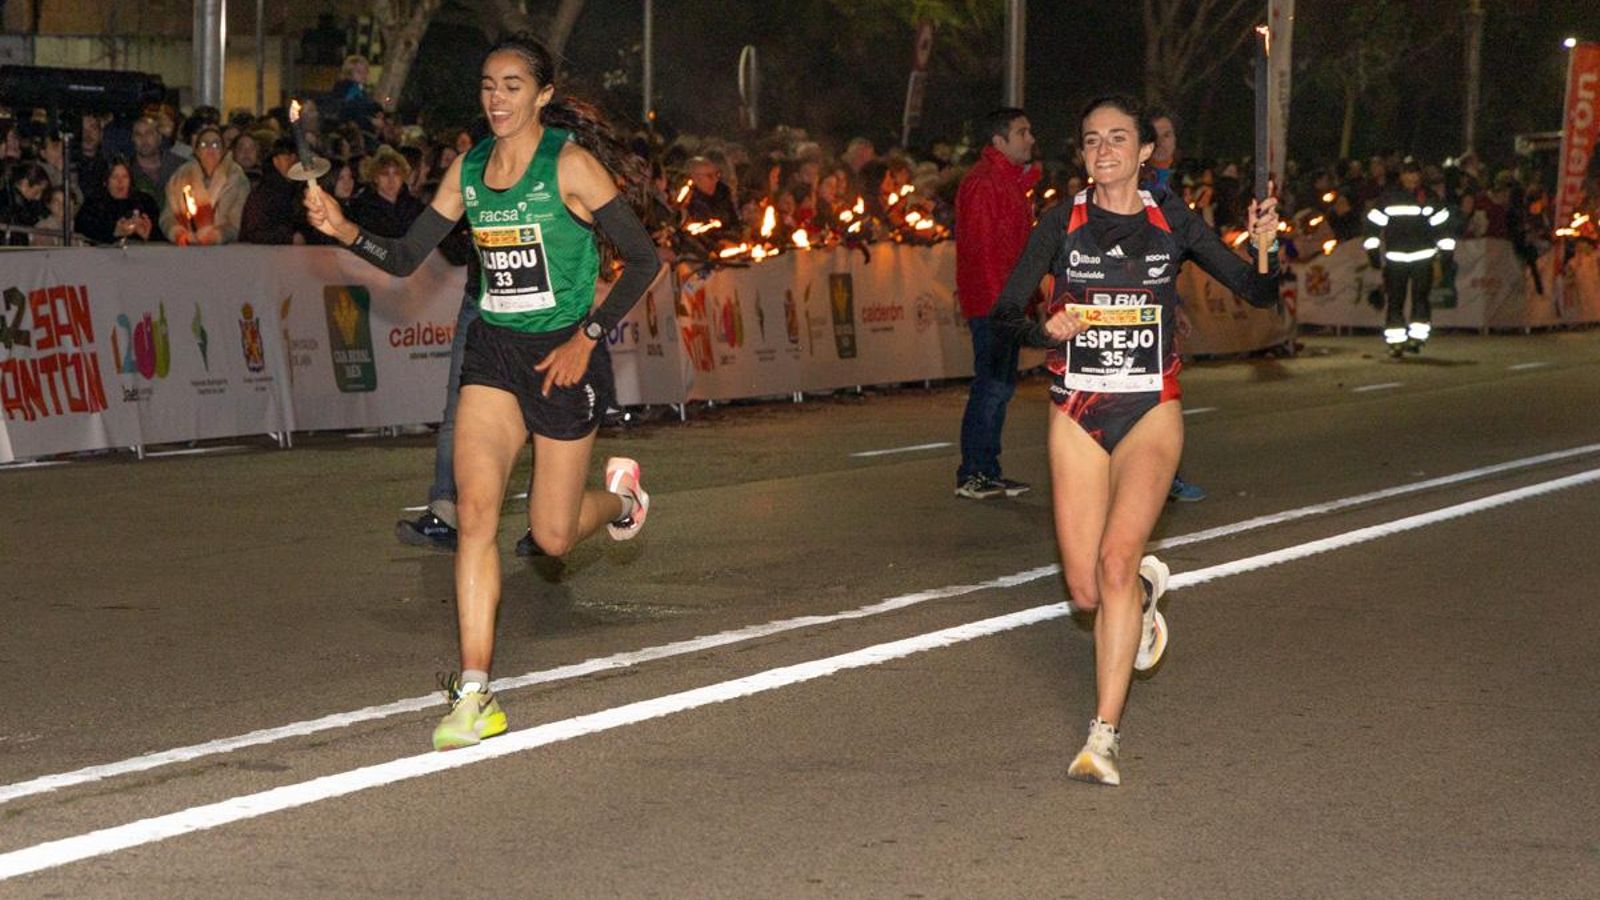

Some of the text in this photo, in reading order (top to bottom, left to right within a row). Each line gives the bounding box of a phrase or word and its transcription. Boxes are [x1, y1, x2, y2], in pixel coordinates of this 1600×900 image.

[479, 208, 520, 223] Facsa
[1069, 249, 1101, 267] Bilbao
[494, 271, 514, 287] 33
[28, 284, 95, 351] SAN
[1085, 309, 1103, 323] 42
[389, 320, 453, 348] calder
[1075, 329, 1154, 349] ESPEJO
[1101, 350, 1124, 367] 35
